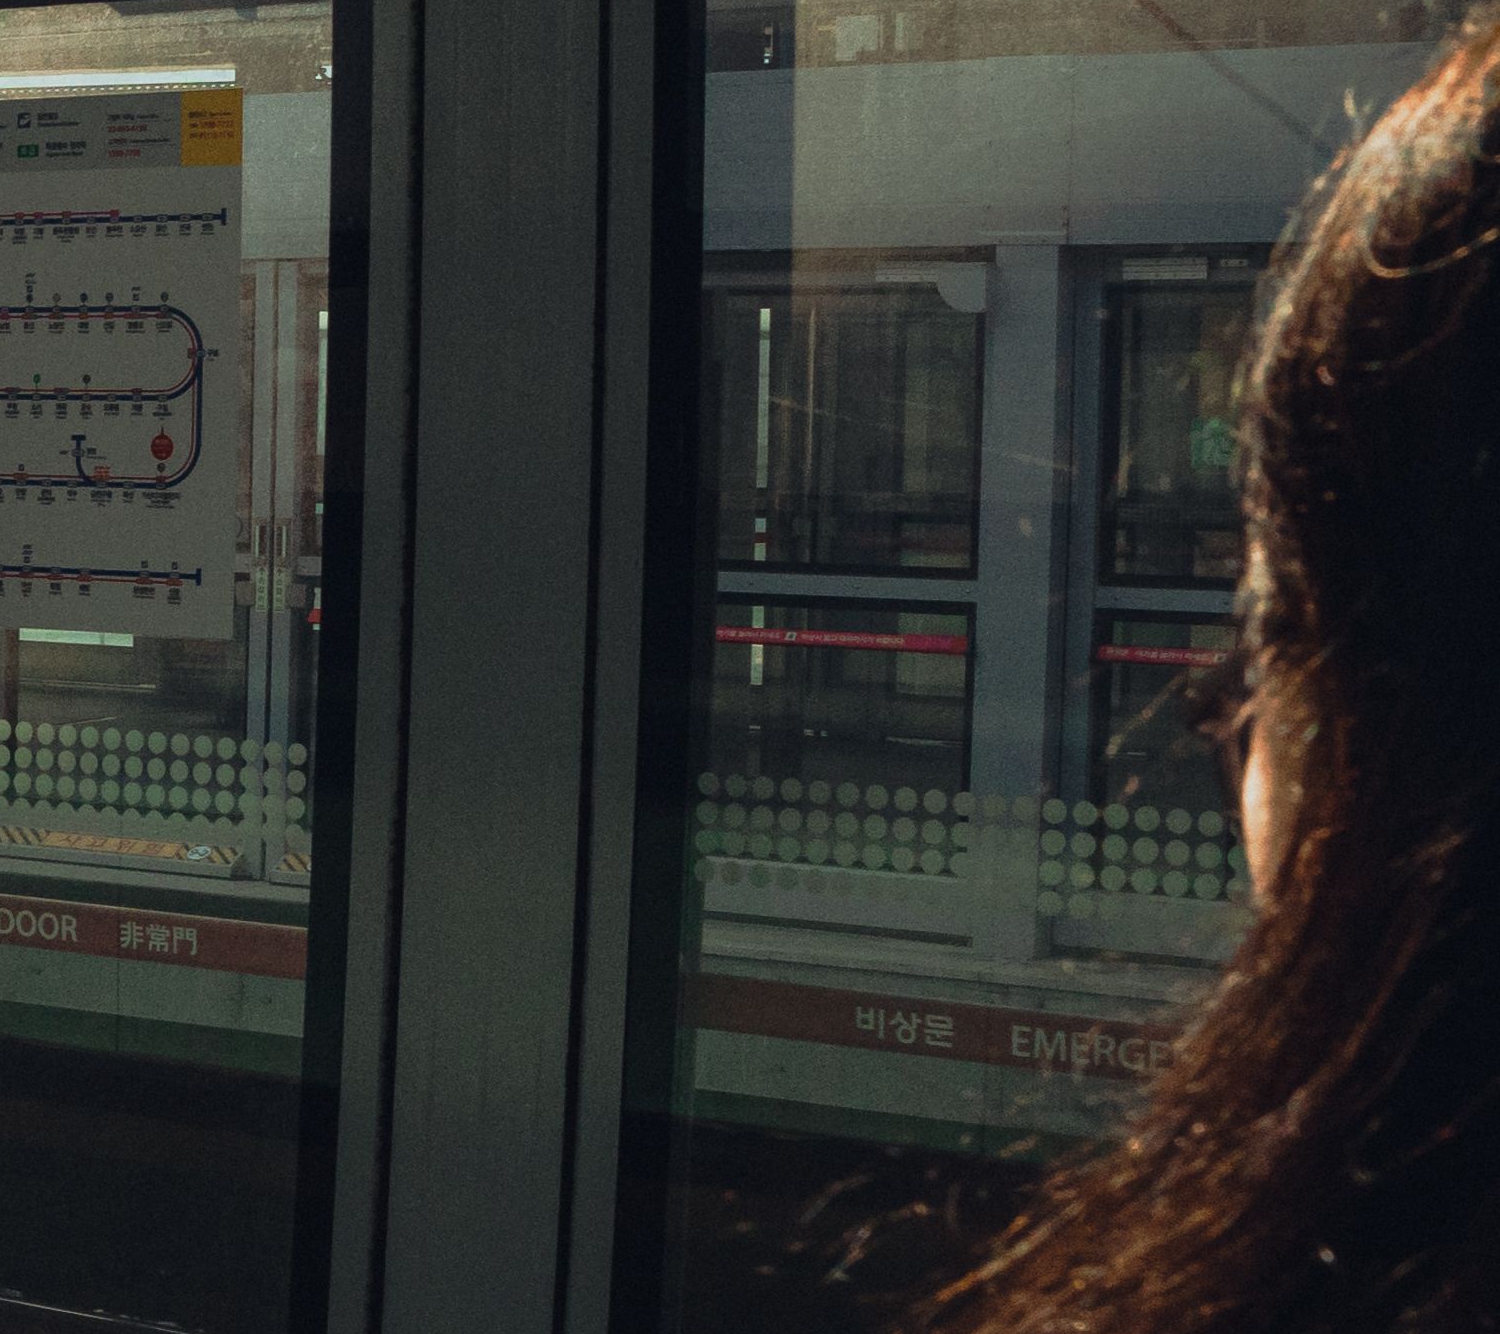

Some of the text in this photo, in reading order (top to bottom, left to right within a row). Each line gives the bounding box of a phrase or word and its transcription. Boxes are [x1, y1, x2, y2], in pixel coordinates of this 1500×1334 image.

[118, 920, 199, 958] 非常門
[854, 1005, 957, 1049] 비상문
